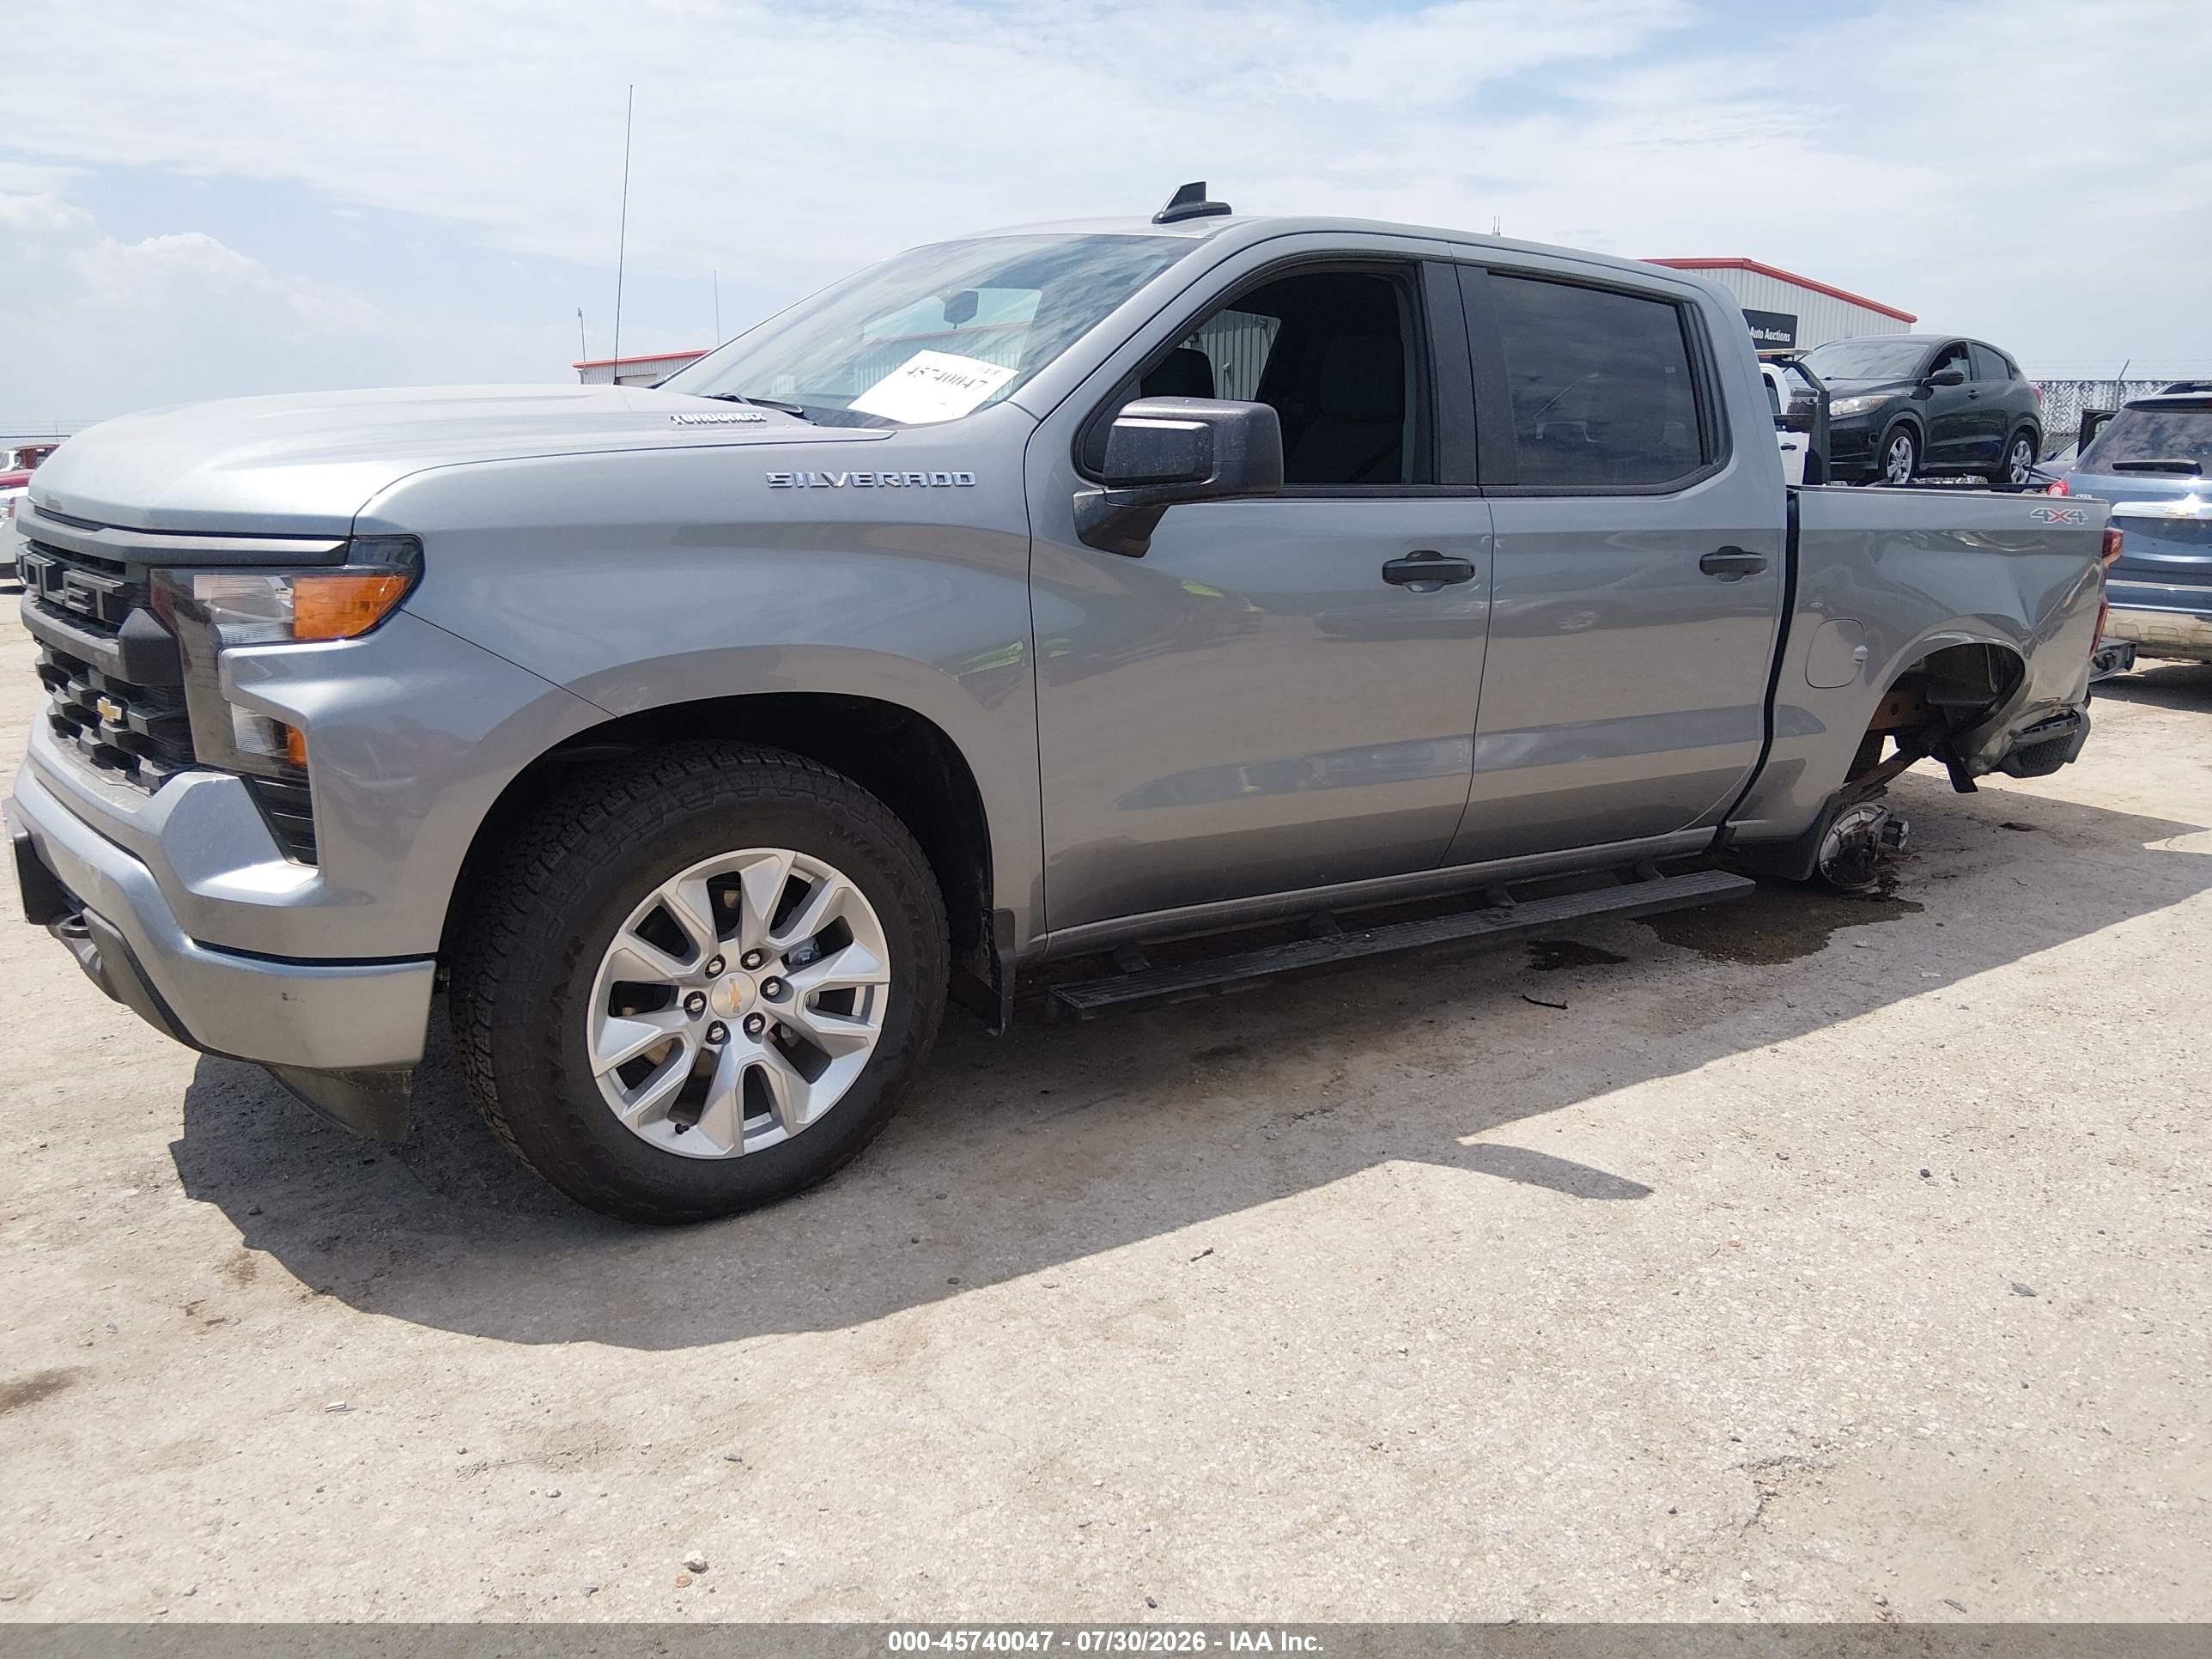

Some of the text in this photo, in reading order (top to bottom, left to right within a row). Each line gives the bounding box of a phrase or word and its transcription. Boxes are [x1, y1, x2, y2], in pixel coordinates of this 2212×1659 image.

[1750, 326, 1790, 342] Auto Auctions
[766, 471, 976, 488] SILVERADO
